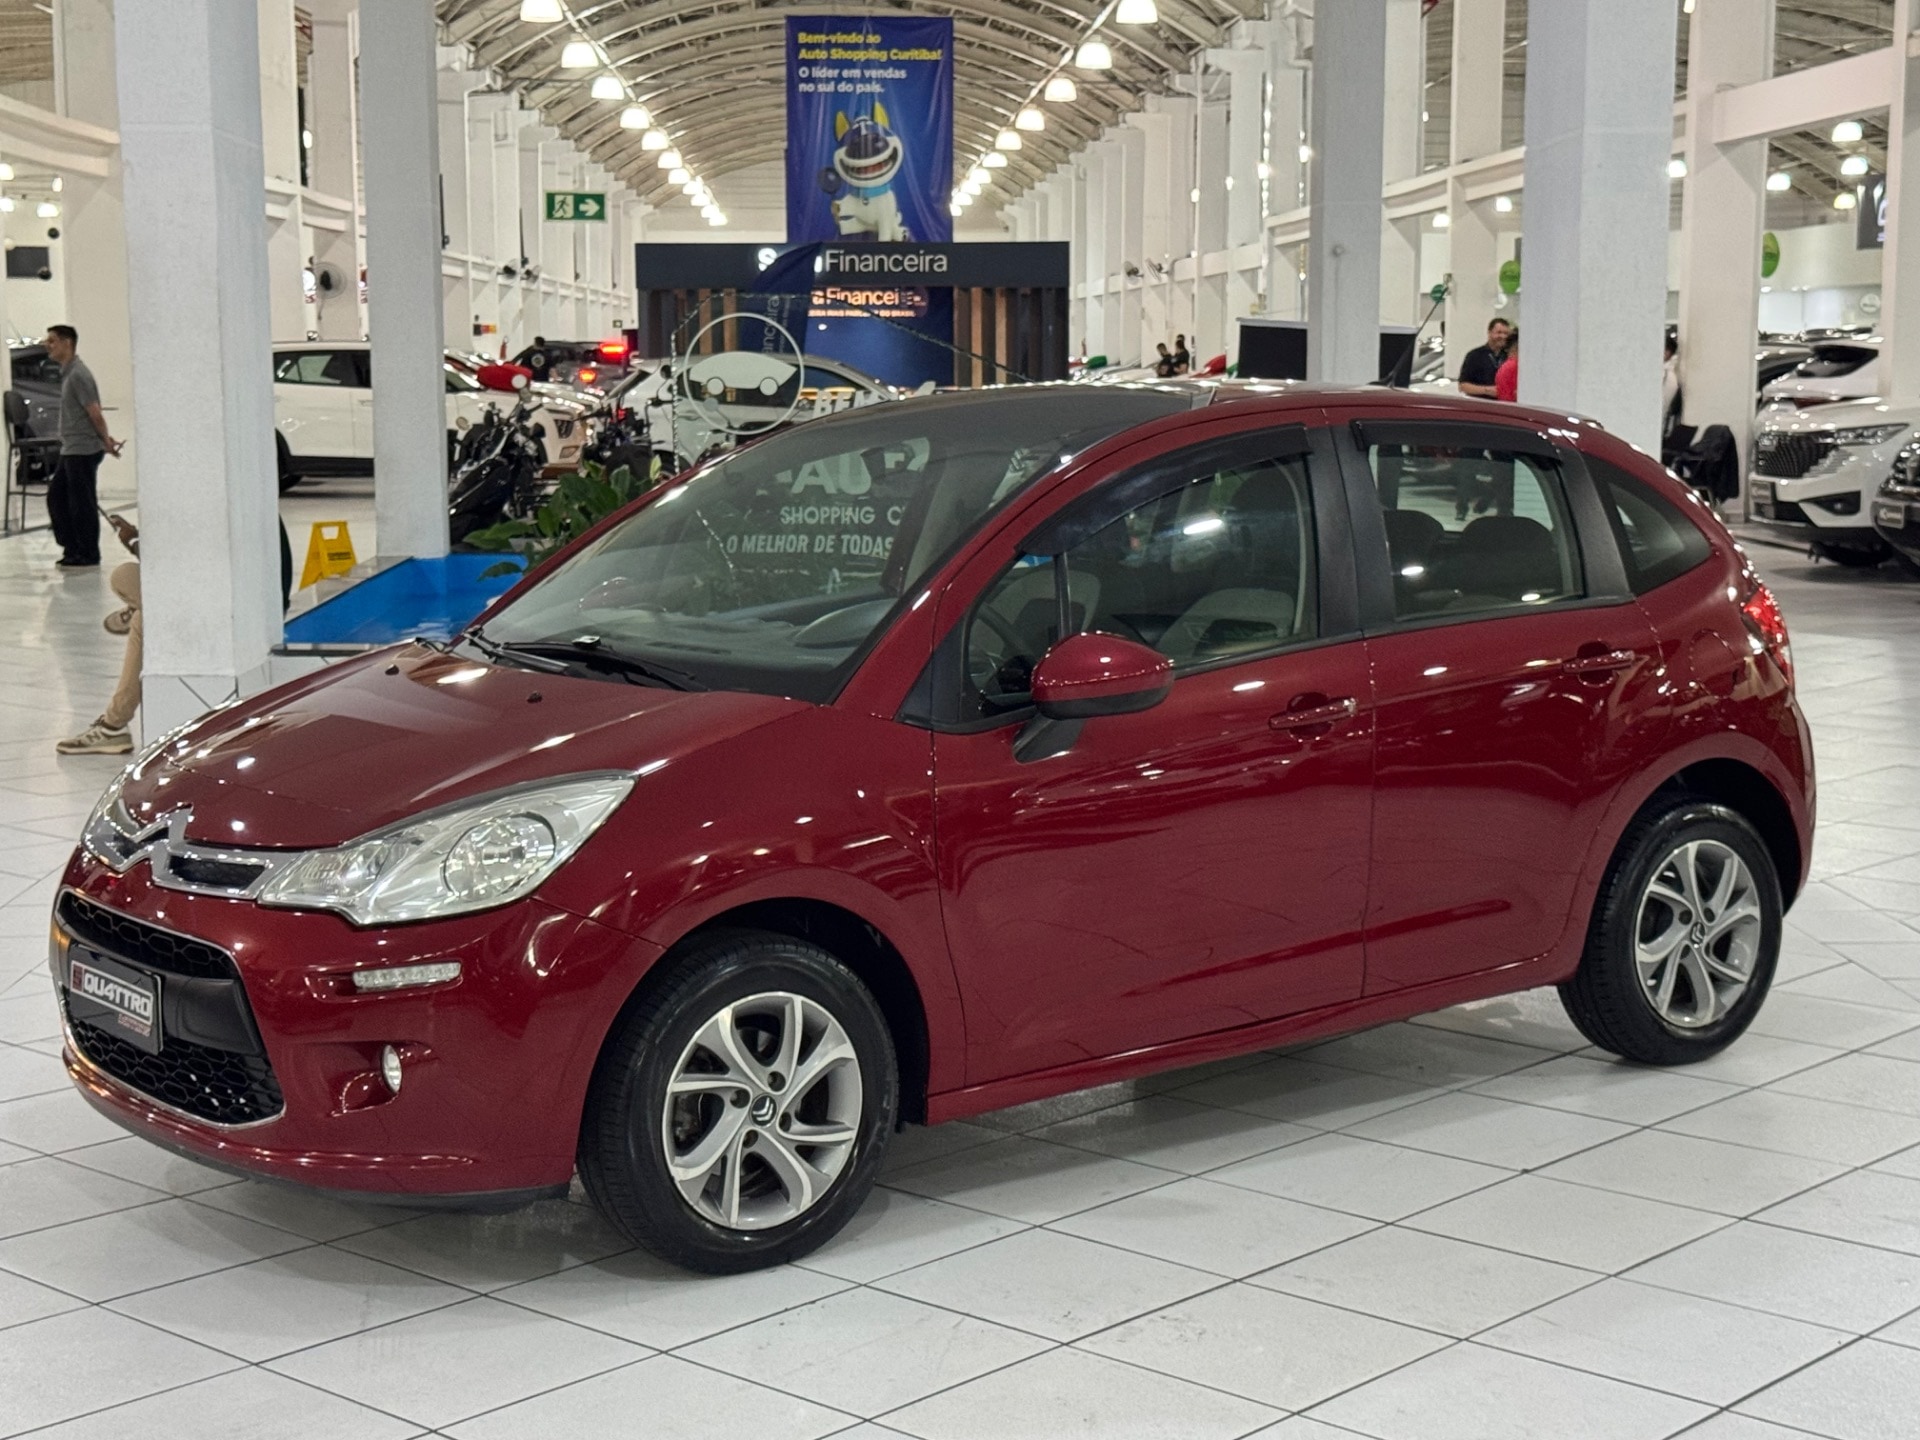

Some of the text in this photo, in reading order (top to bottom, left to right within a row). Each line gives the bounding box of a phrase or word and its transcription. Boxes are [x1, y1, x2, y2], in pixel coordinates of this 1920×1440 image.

[798, 33, 881, 44] Bem-vindo ao
[798, 49, 943, 61] Auto Shopping Curitiba!
[798, 67, 907, 79] O líder em vendas
[798, 82, 885, 94] no sul do país.
[825, 249, 948, 273] Financeira
[826, 287, 914, 306] Financei
[780, 506, 876, 525] SHOPPING
[726, 534, 738, 553] O
[741, 534, 809, 553] MELHOR
[813, 534, 836, 553] DE
